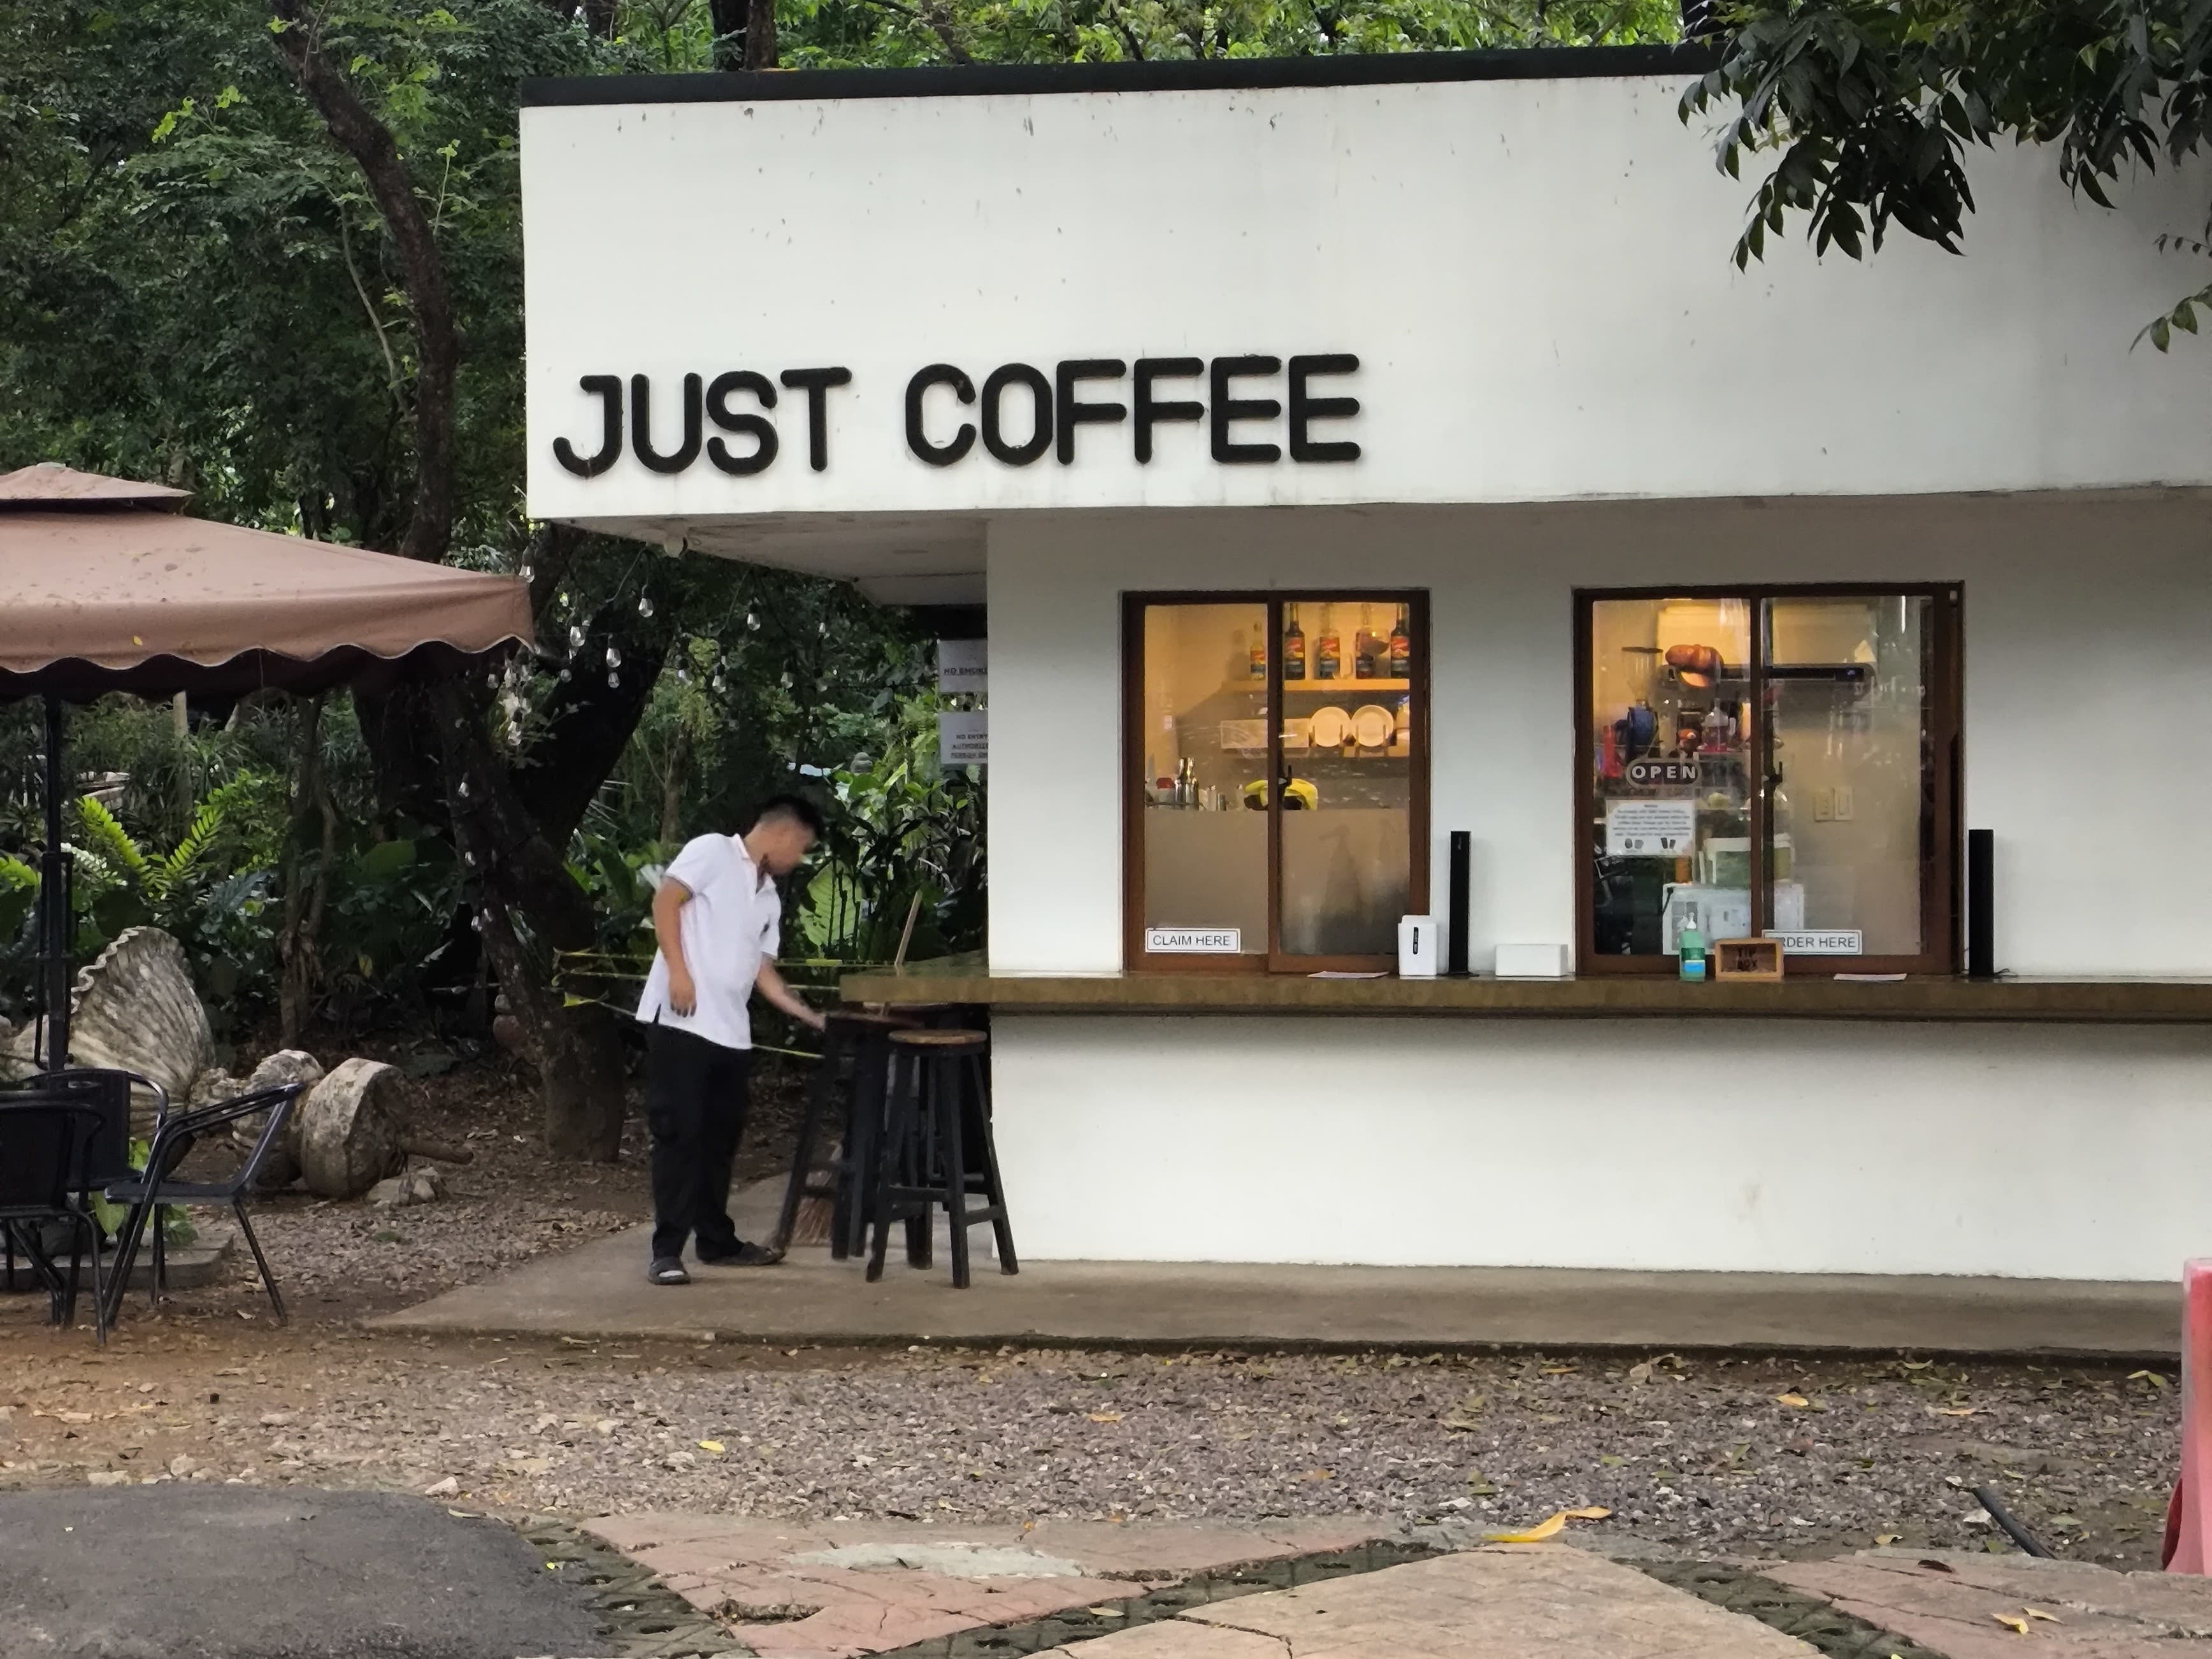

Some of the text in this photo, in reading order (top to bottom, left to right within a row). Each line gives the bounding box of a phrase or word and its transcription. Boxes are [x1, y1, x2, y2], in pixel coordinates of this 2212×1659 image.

[553, 354, 1361, 477] JUST COFFEE
[1632, 766, 1695, 779] OPEN
[1153, 935, 1230, 945] CLAIM HERE
[1782, 937, 1855, 948] RDER HERE
